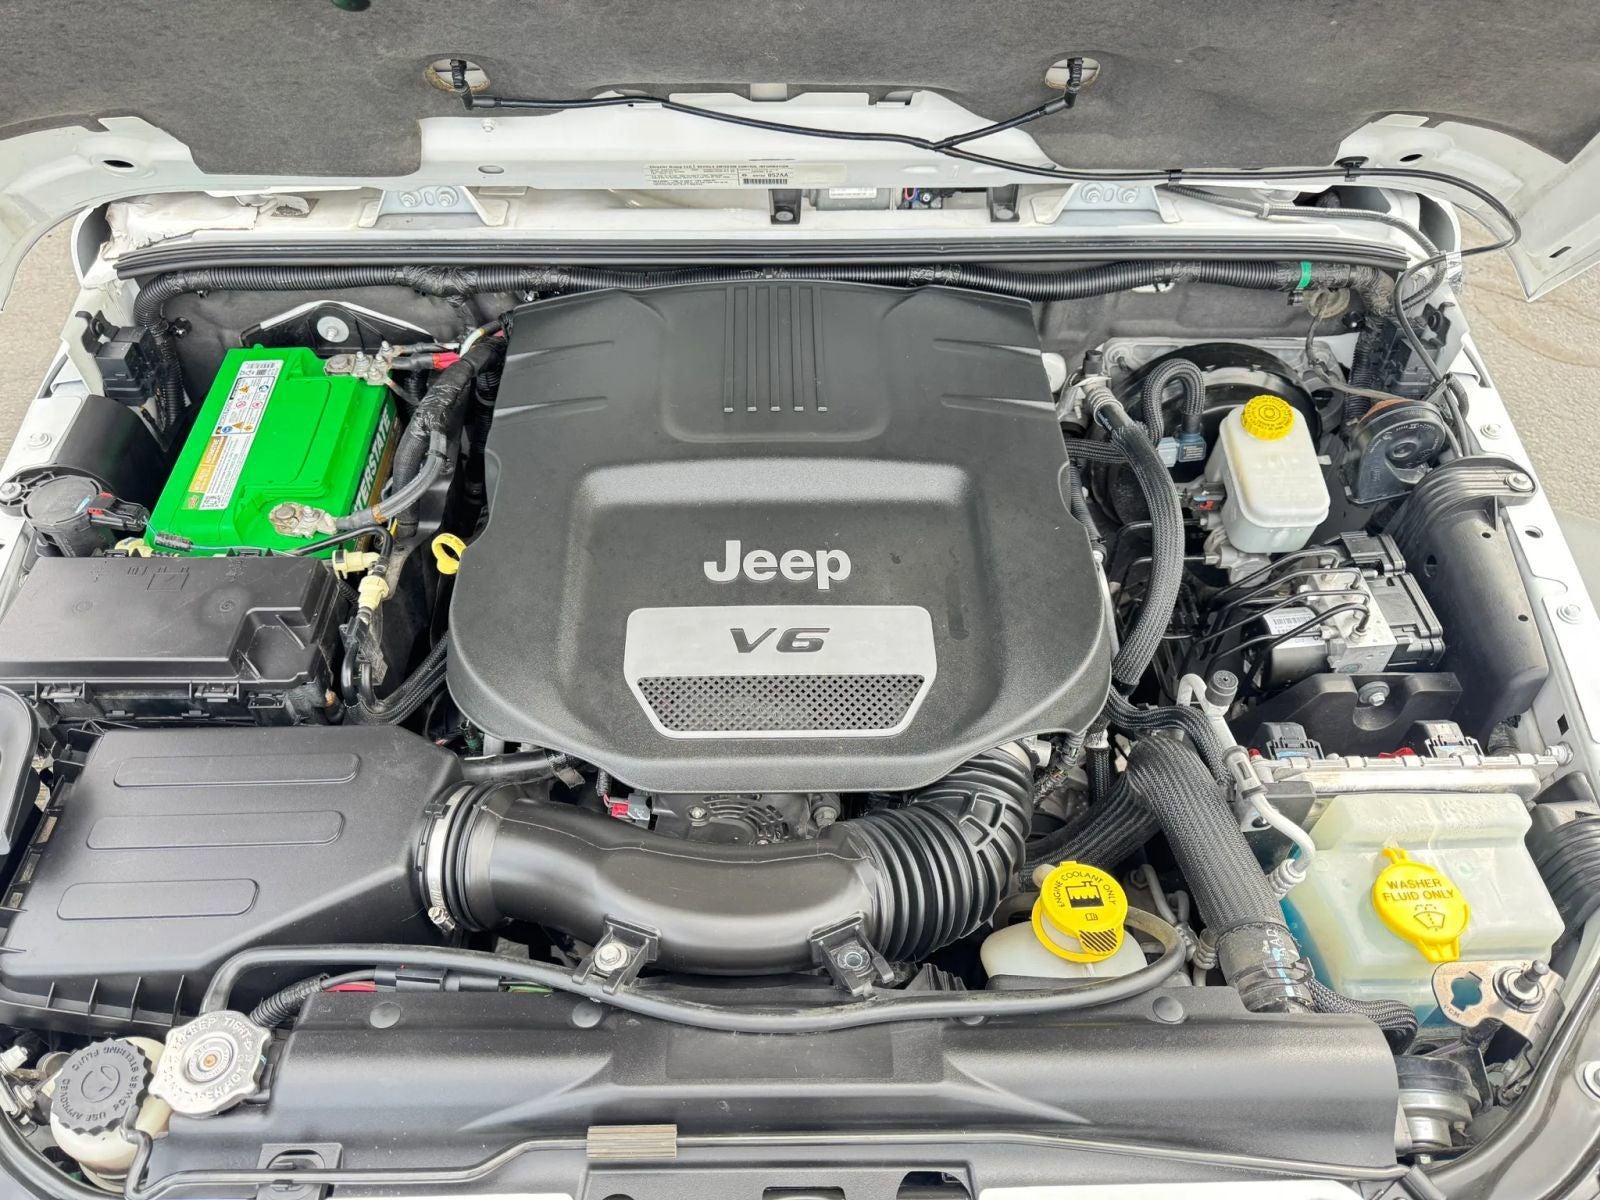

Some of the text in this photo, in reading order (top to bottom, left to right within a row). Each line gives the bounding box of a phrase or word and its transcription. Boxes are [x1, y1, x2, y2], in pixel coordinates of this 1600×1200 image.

[353, 403, 391, 512] TERSTATE
[703, 540, 852, 590] Jeep
[730, 627, 831, 653] V6
[1053, 871, 1117, 908] ENGINE COOLANT ONLY
[1382, 889, 1454, 902] FLUID ONLY
[1386, 878, 1442, 890] WASHER
[223, 1017, 252, 1040] TIGHT
[71, 1049, 99, 1072] FLUID
[103, 1046, 139, 1073] STEERING
[60, 1078, 84, 1120] APPROVED
